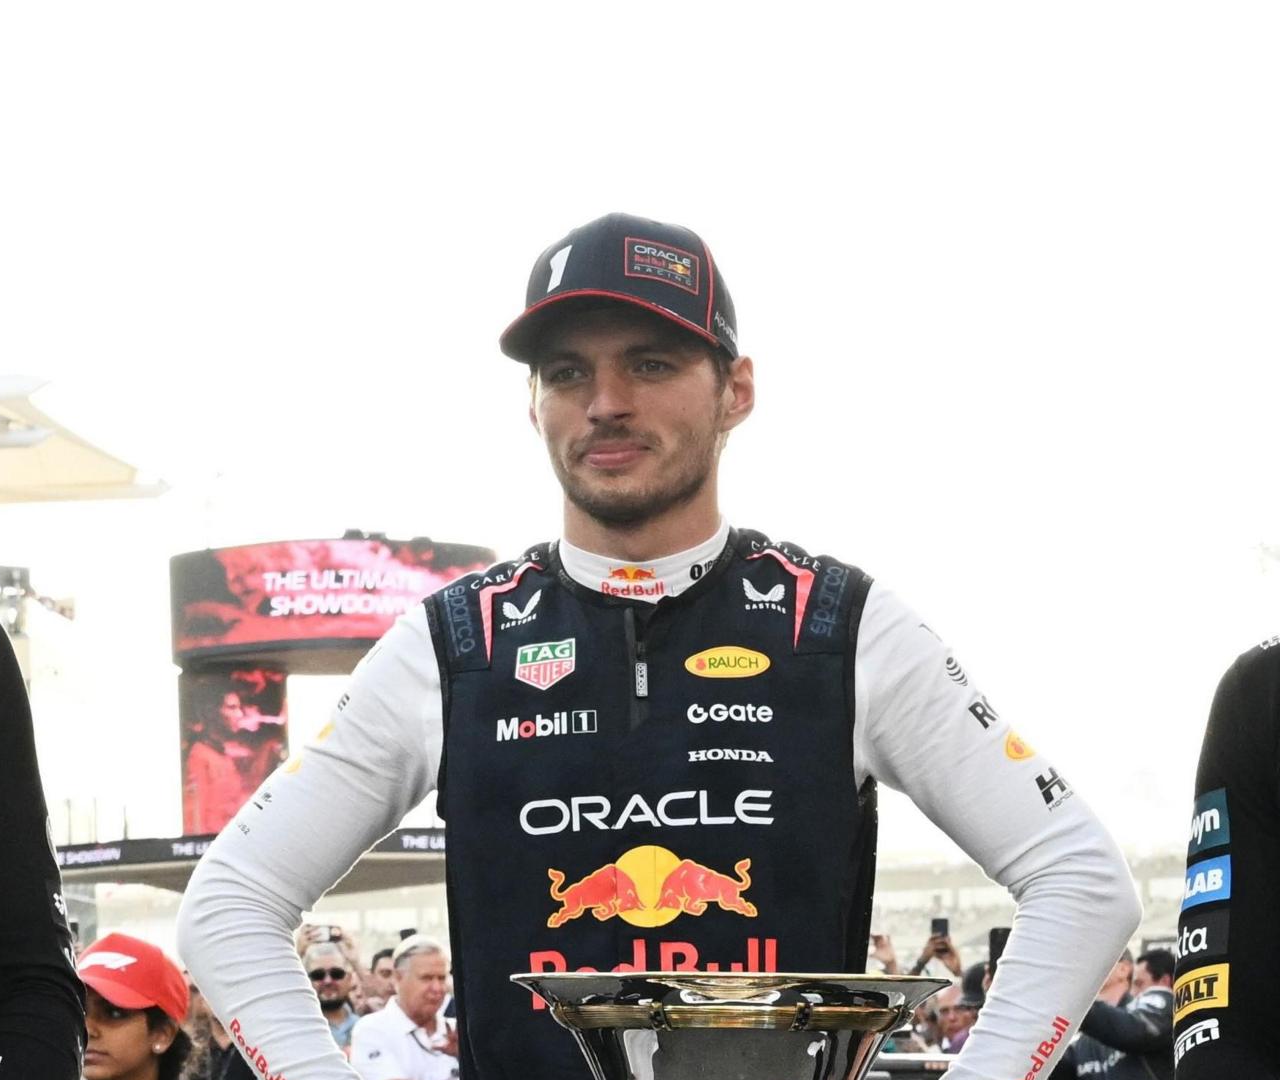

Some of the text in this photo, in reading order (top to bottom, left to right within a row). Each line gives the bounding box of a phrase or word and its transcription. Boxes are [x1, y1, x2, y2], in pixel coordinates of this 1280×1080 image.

[634, 245, 691, 267] ORACLE
[633, 265, 692, 286] RACING
[263, 570, 308, 592] THE
[601, 581, 665, 597] Red Bull
[445, 584, 476, 656] sparco
[521, 643, 571, 663] TAG
[707, 655, 760, 670] RAUCH
[519, 661, 573, 689] HEUER
[496, 711, 568, 742] Mobil
[687, 748, 775, 763] HONDA
[519, 789, 775, 836] ORACLE
[229, 1018, 258, 1060] Red
[1037, 1015, 1071, 1064] Bull
